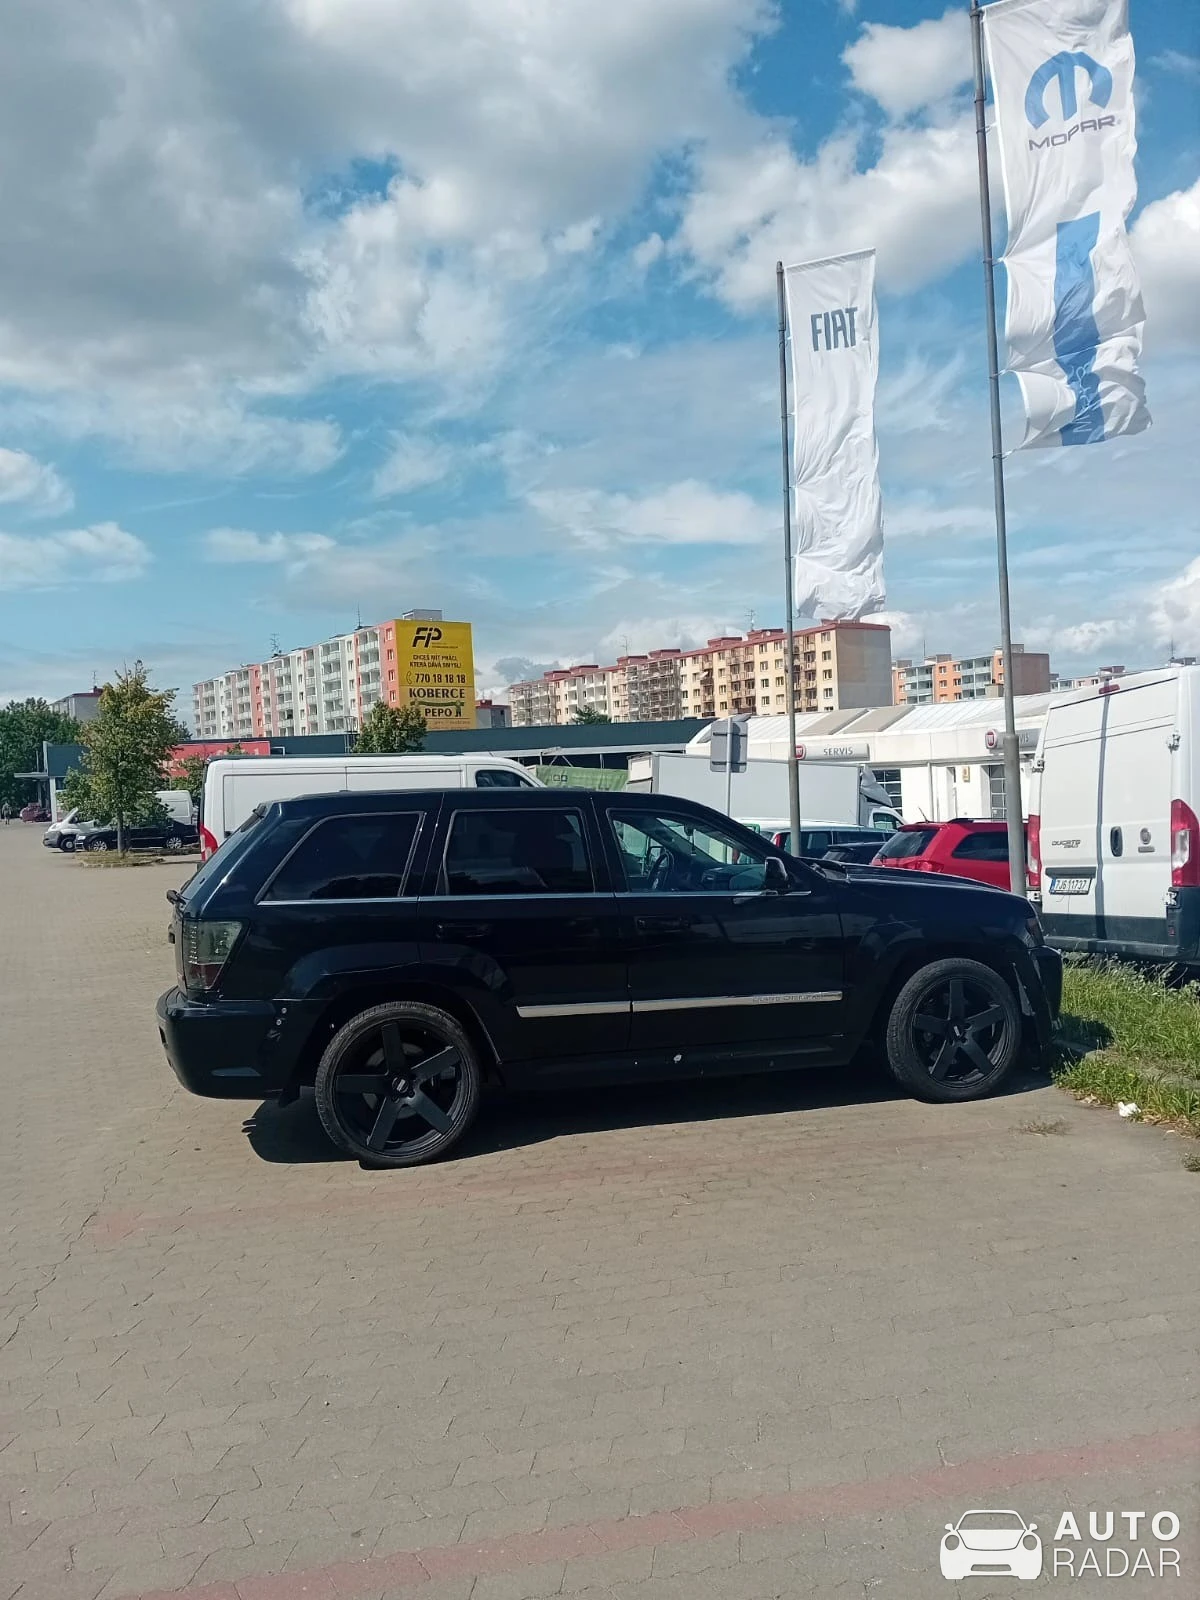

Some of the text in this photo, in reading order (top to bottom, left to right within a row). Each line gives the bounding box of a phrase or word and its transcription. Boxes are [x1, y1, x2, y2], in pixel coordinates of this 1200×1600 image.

[1029, 115, 1115, 151] MOPAR
[811, 307, 858, 352] FIAT
[415, 674, 466, 684] 770 18 18 18
[409, 688, 465, 698] KOBERCE
[425, 708, 452, 717] PEPO
[823, 747, 853, 756] SERVIS
